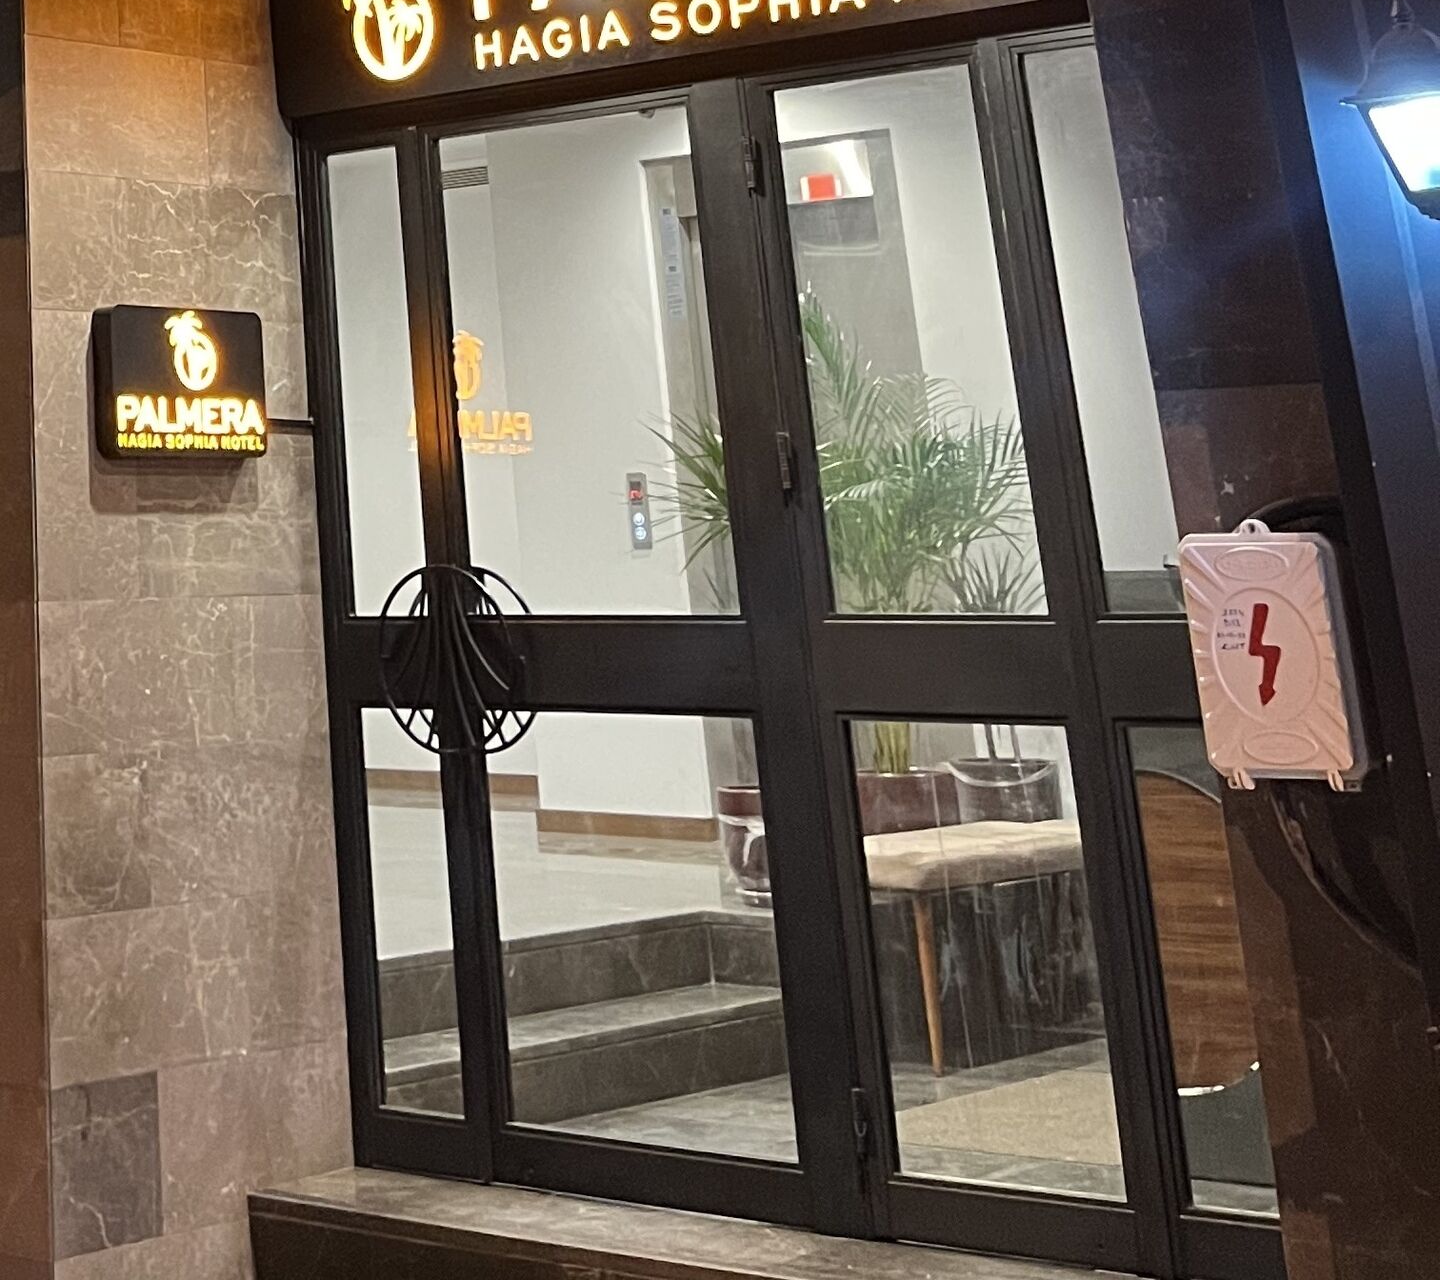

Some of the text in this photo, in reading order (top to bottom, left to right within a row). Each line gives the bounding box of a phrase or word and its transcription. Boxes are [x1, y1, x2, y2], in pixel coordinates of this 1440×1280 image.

[474, 14, 630, 70] HAGIA
[117, 395, 265, 434] PALMERA
[118, 434, 264, 450] HAGIA SOPHIA HOTEL
